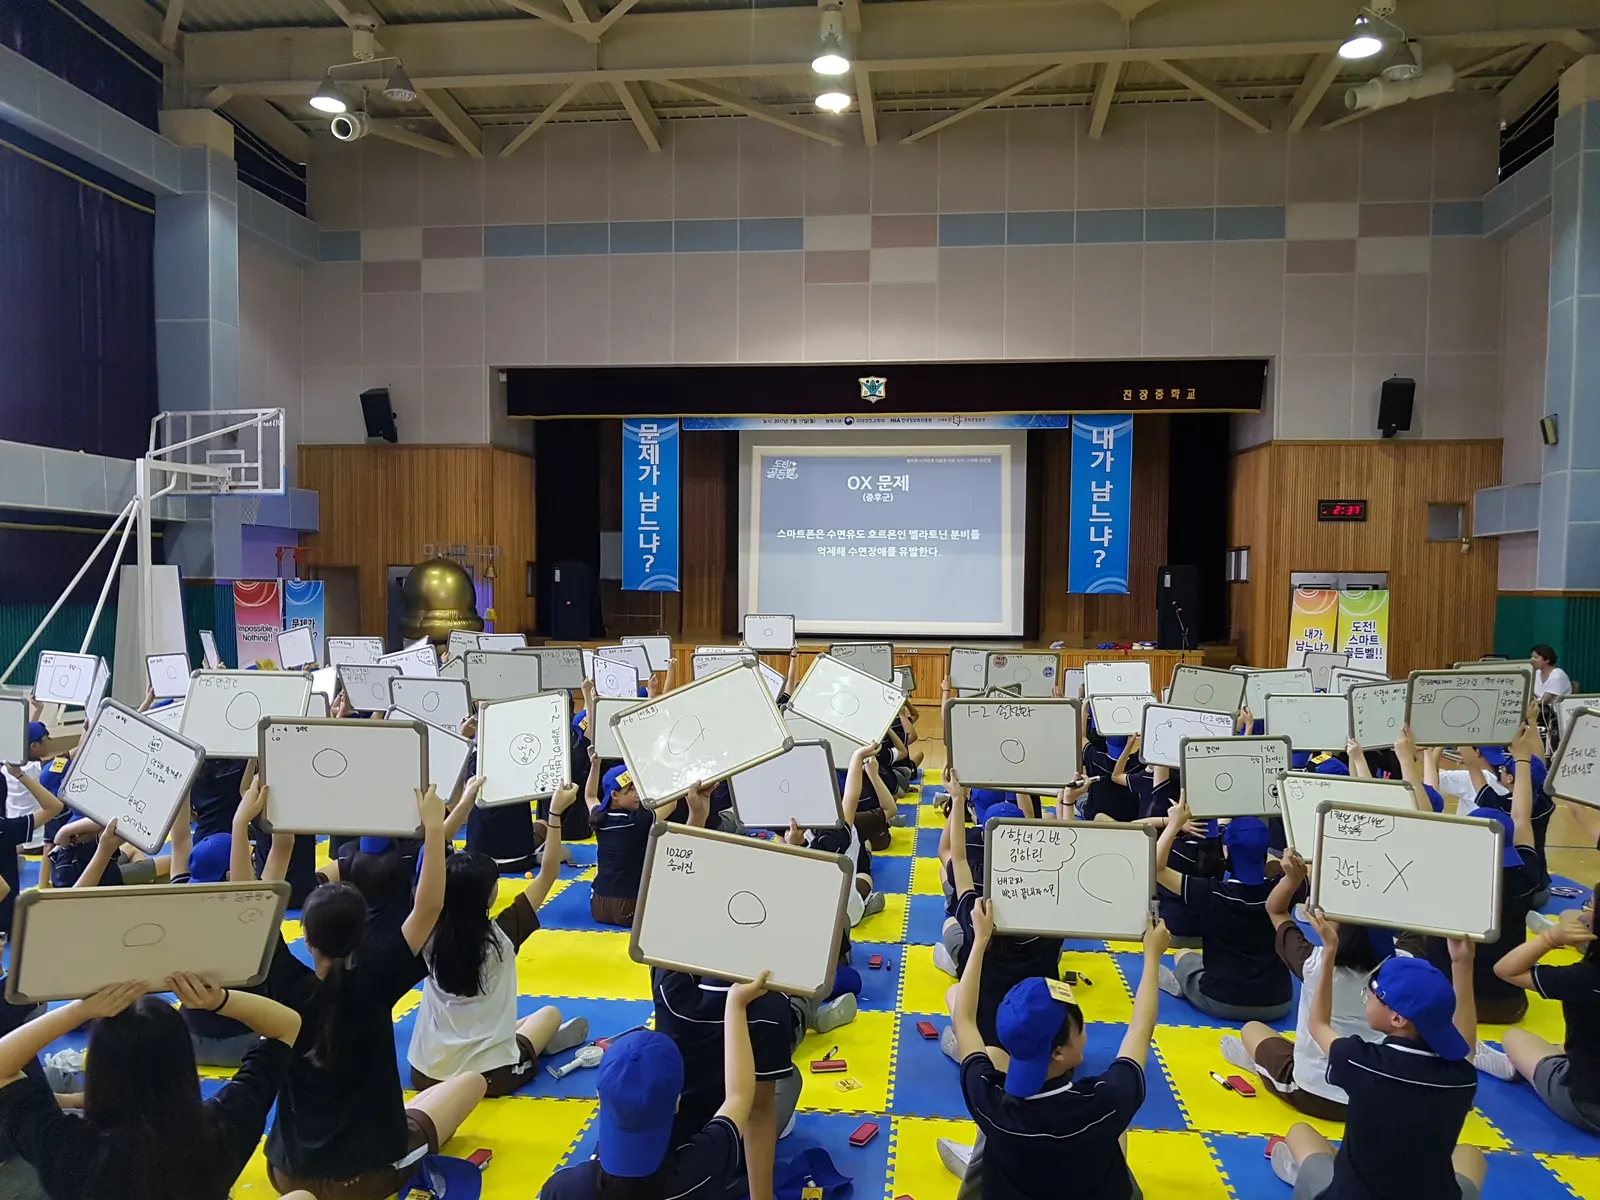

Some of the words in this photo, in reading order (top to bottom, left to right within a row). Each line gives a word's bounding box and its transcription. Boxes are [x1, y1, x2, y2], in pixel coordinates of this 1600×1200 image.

[1122, 388, 1196, 401] 진장중학교
[638, 423, 660, 486] 문제가
[1089, 428, 1114, 473] 내가
[847, 475, 873, 490] OX
[876, 474, 909, 492] 문제
[1333, 505, 1361, 515] 2:37
[1088, 480, 1114, 568] 남느냐?
[638, 491, 660, 573] 남느냐?
[776, 529, 825, 540] 스마트폰은
[826, 529, 866, 540] 수면유도
[867, 529, 907, 540] 호르몬인
[908, 529, 949, 540] 멜라토닌
[950, 529, 981, 541] 분비를
[816, 546, 846, 557] 억제해
[847, 546, 897, 557] 수면장애를
[898, 546, 942, 557] 유발한다.
[238, 623, 273, 634] Impossible
[1351, 620, 1376, 634] 도전!
[242, 633, 273, 643] Nothing!!
[1304, 628, 1323, 641] 내가
[1348, 634, 1380, 646] 스마트
[1295, 640, 1330, 653] 남느냐?
[1343, 647, 1383, 660] 골든벨!!
[967, 705, 990, 718] 1-2
[1000, 828, 1034, 845] 1학년
[666, 846, 694, 859] 10208
[1010, 847, 1044, 863] 김하린
[667, 858, 695, 875] 송이진
